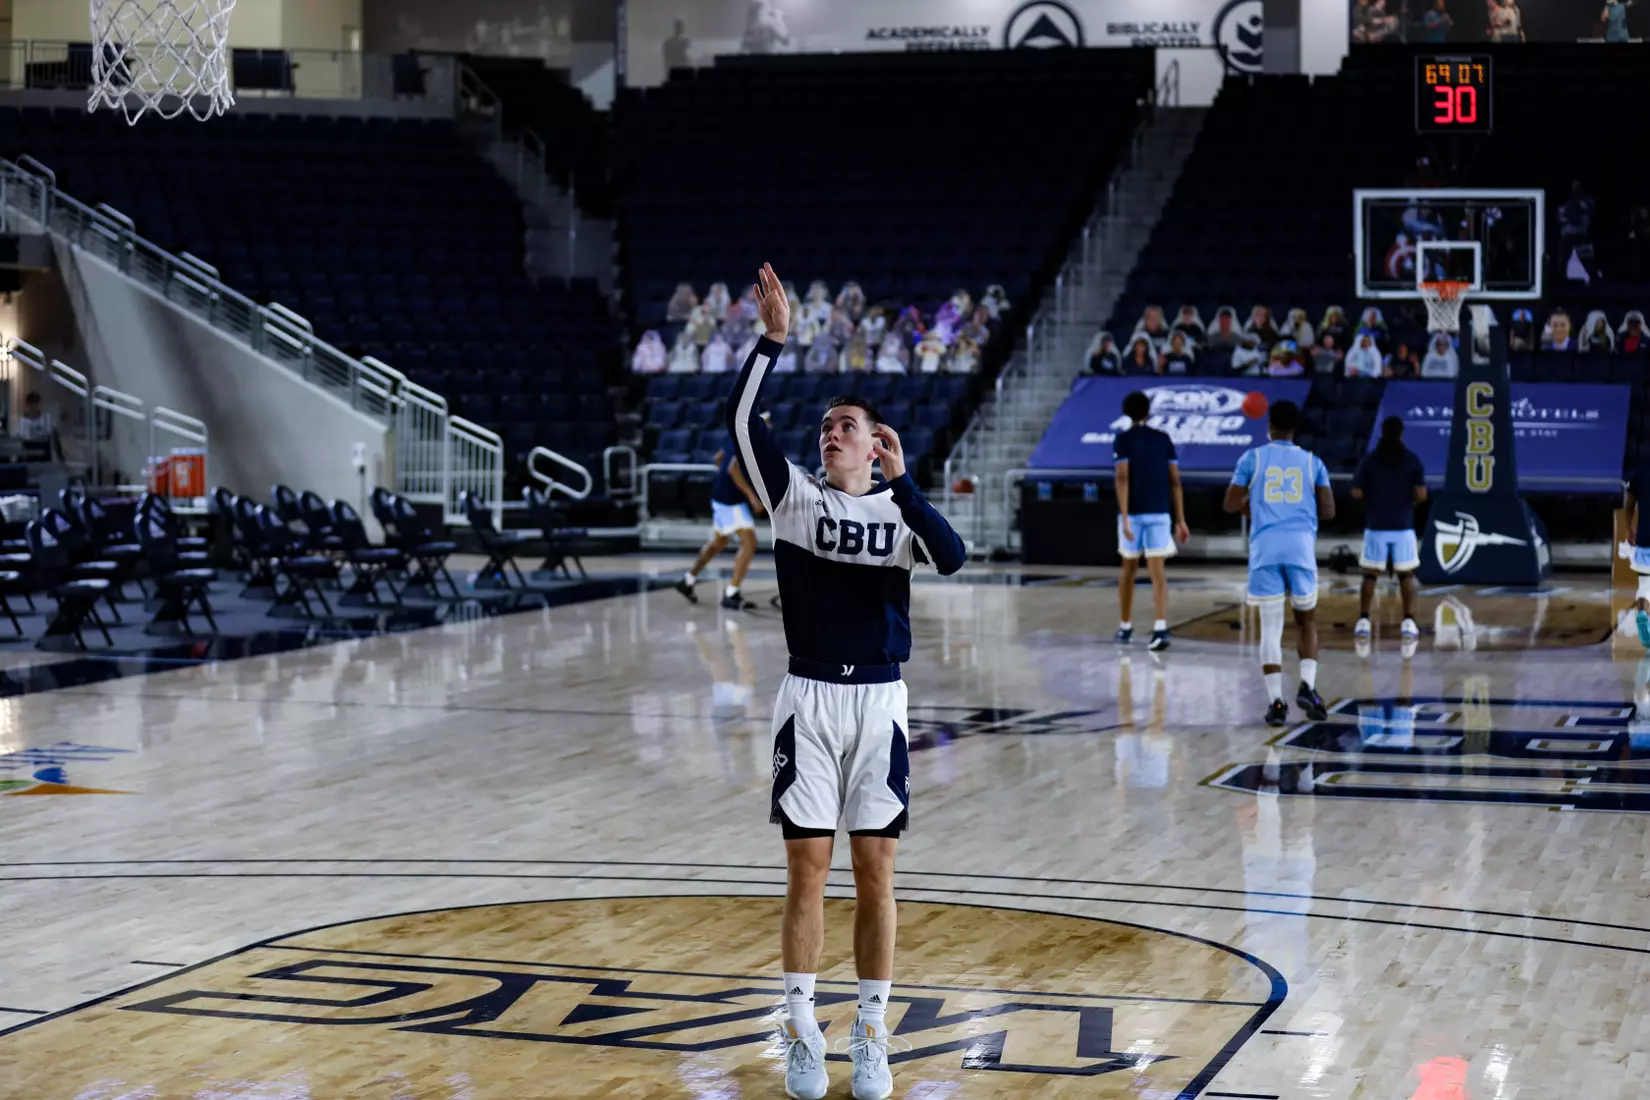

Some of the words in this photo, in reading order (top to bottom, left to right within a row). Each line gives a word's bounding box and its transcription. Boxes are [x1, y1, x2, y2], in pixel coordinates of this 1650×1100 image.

[866, 26, 992, 41] ACADEMICALLY
[1434, 85, 1477, 123] 30
[1464, 381, 1495, 493] CBU
[1264, 466, 1303, 503] 23
[815, 516, 896, 557] CBU
